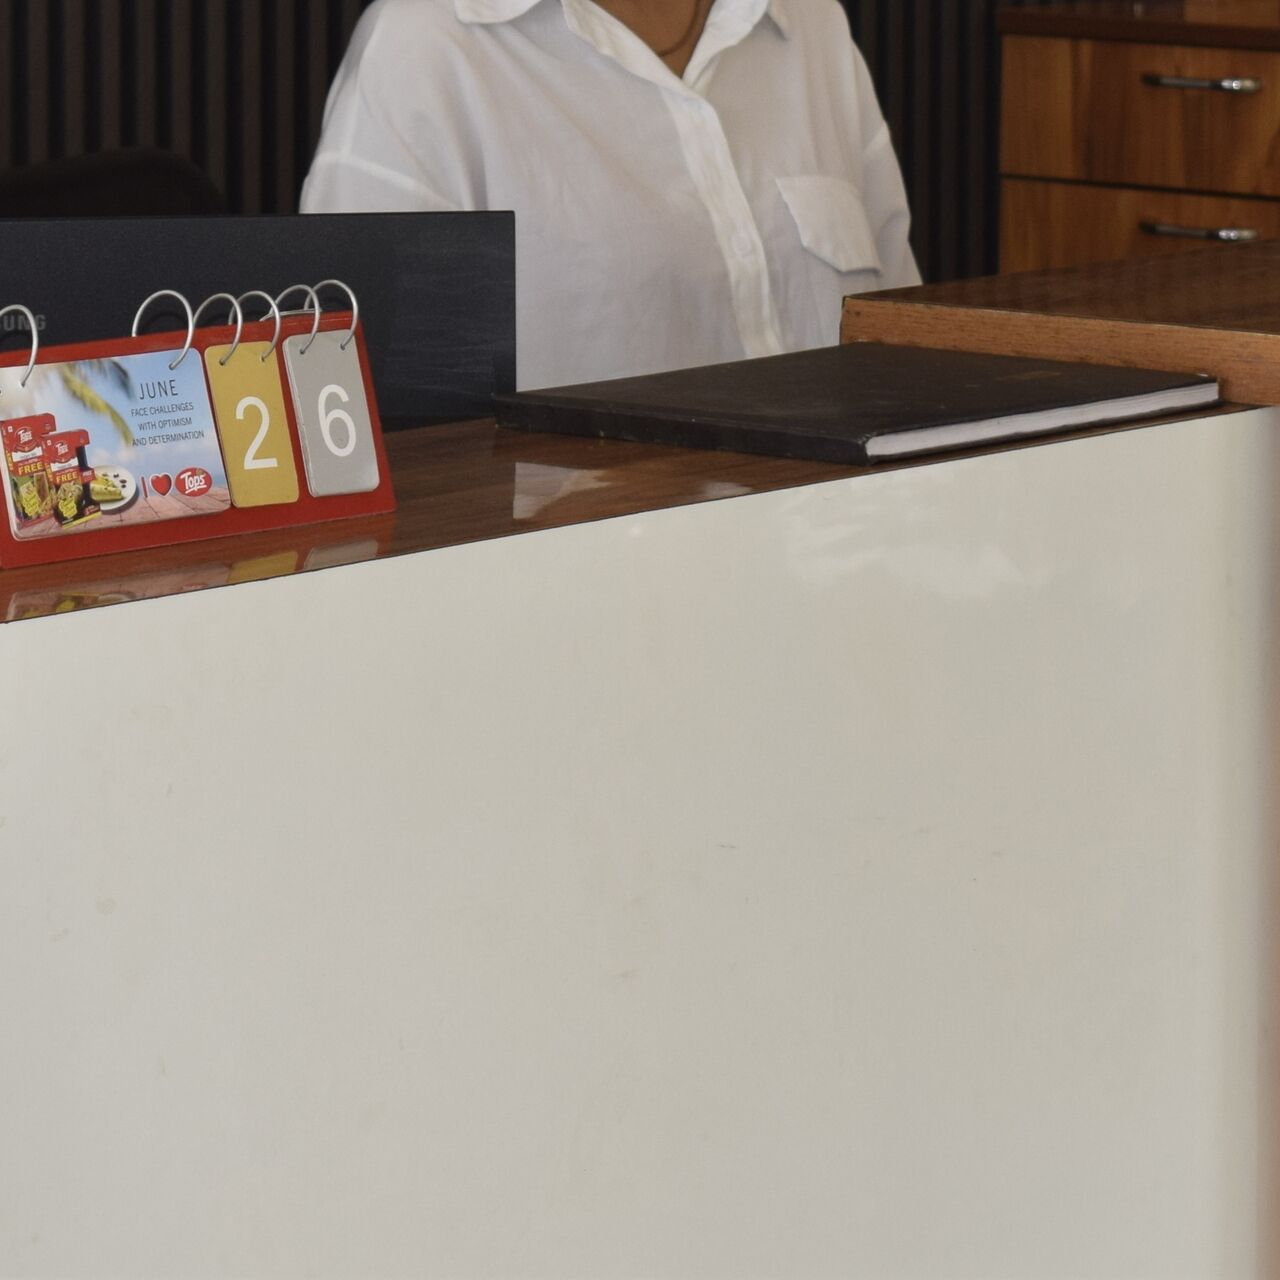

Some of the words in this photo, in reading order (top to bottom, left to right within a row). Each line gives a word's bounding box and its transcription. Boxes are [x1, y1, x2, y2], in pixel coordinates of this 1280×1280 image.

[140, 379, 178, 400] JUNE
[131, 407, 148, 417] FACE
[149, 402, 194, 415] CHALLENGES
[138, 420, 157, 431] WITH
[158, 417, 192, 429] OPTIMISM
[318, 384, 358, 458] 6
[132, 436, 147, 447] AND
[149, 431, 205, 445] DETERMINATION
[235, 396, 278, 470] 2
[18, 461, 44, 475] FREE
[56, 471, 78, 483] FREE
[141, 476, 148, 498] I
[180, 471, 207, 494] Tops
